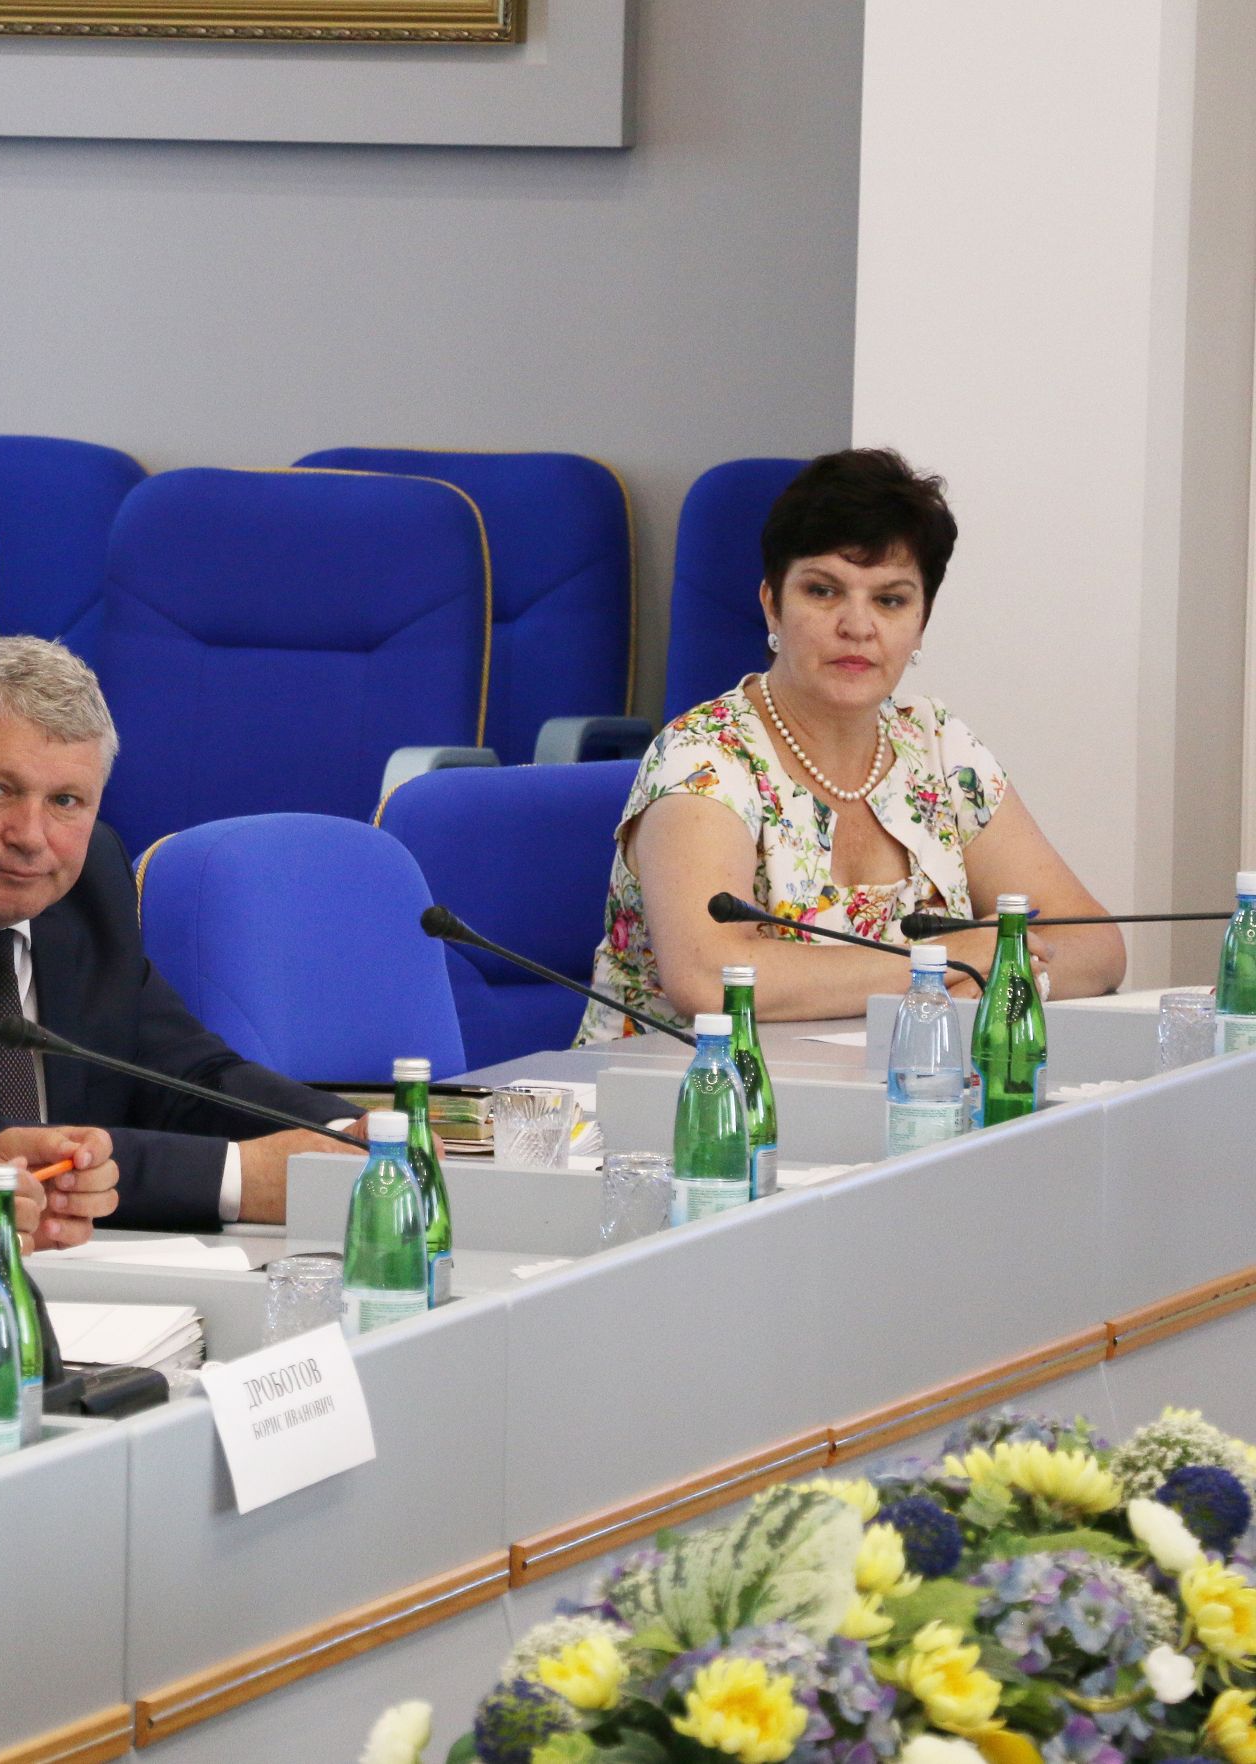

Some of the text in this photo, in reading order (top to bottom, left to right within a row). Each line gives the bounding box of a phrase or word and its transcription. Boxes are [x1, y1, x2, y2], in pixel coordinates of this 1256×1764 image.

[243, 1358, 322, 1410] ДРОБОТОВ
[252, 1395, 336, 1440] БОРИС ИВАНОВИЧ
